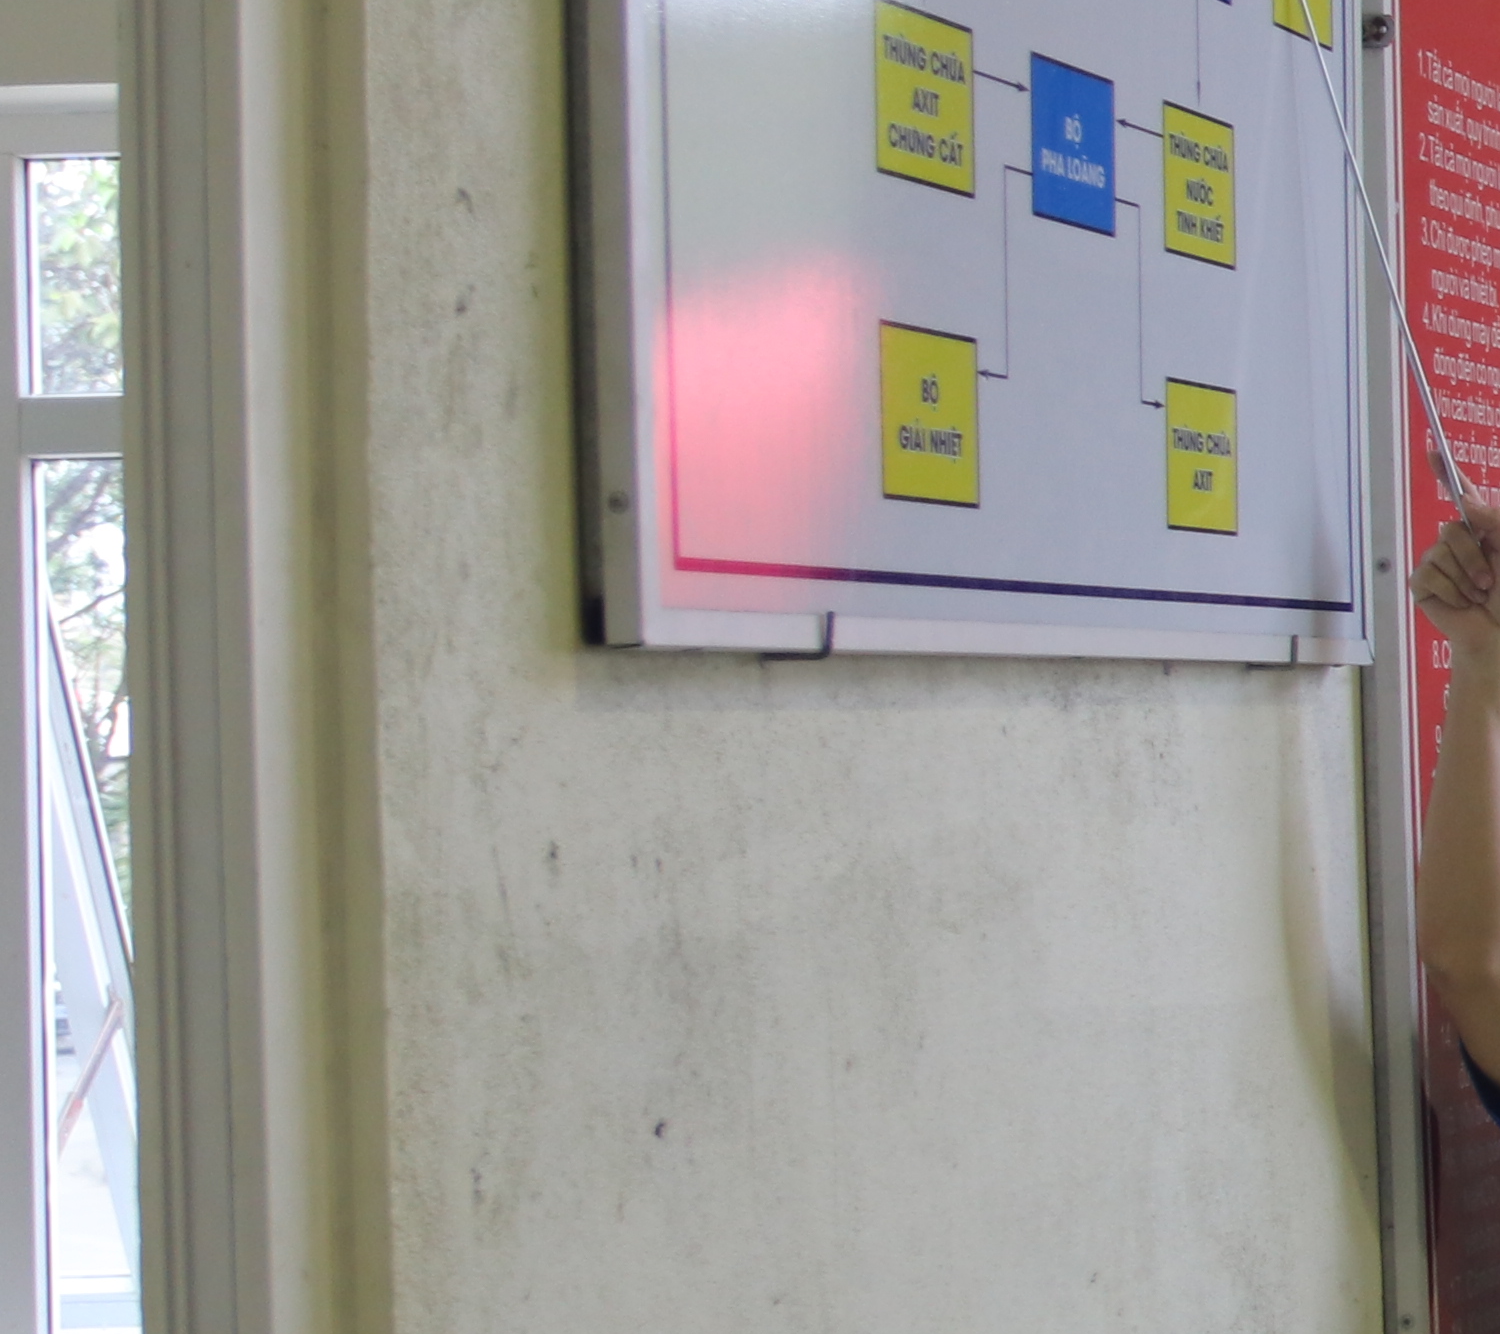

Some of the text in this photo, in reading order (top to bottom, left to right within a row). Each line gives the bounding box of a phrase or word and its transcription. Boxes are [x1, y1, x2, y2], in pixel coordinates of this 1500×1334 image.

[882, 31, 967, 85] THÙNG CHỨA
[911, 87, 940, 118] AXIT
[888, 122, 965, 167] CHƯNG CẤT
[1064, 114, 1082, 148] BỘ
[1040, 147, 1106, 188] PHA LOÃNG
[1168, 132, 1230, 174] THÙNG CHỨA
[1185, 178, 1213, 207] NƯỚC
[1176, 209, 1224, 243] TINH KHIẾT
[920, 373, 940, 408] BỘ
[897, 424, 963, 460] GIẢI NHIỆT
[1171, 425, 1232, 460] THÙNG CHỨA
[1192, 467, 1214, 494] AXIT
